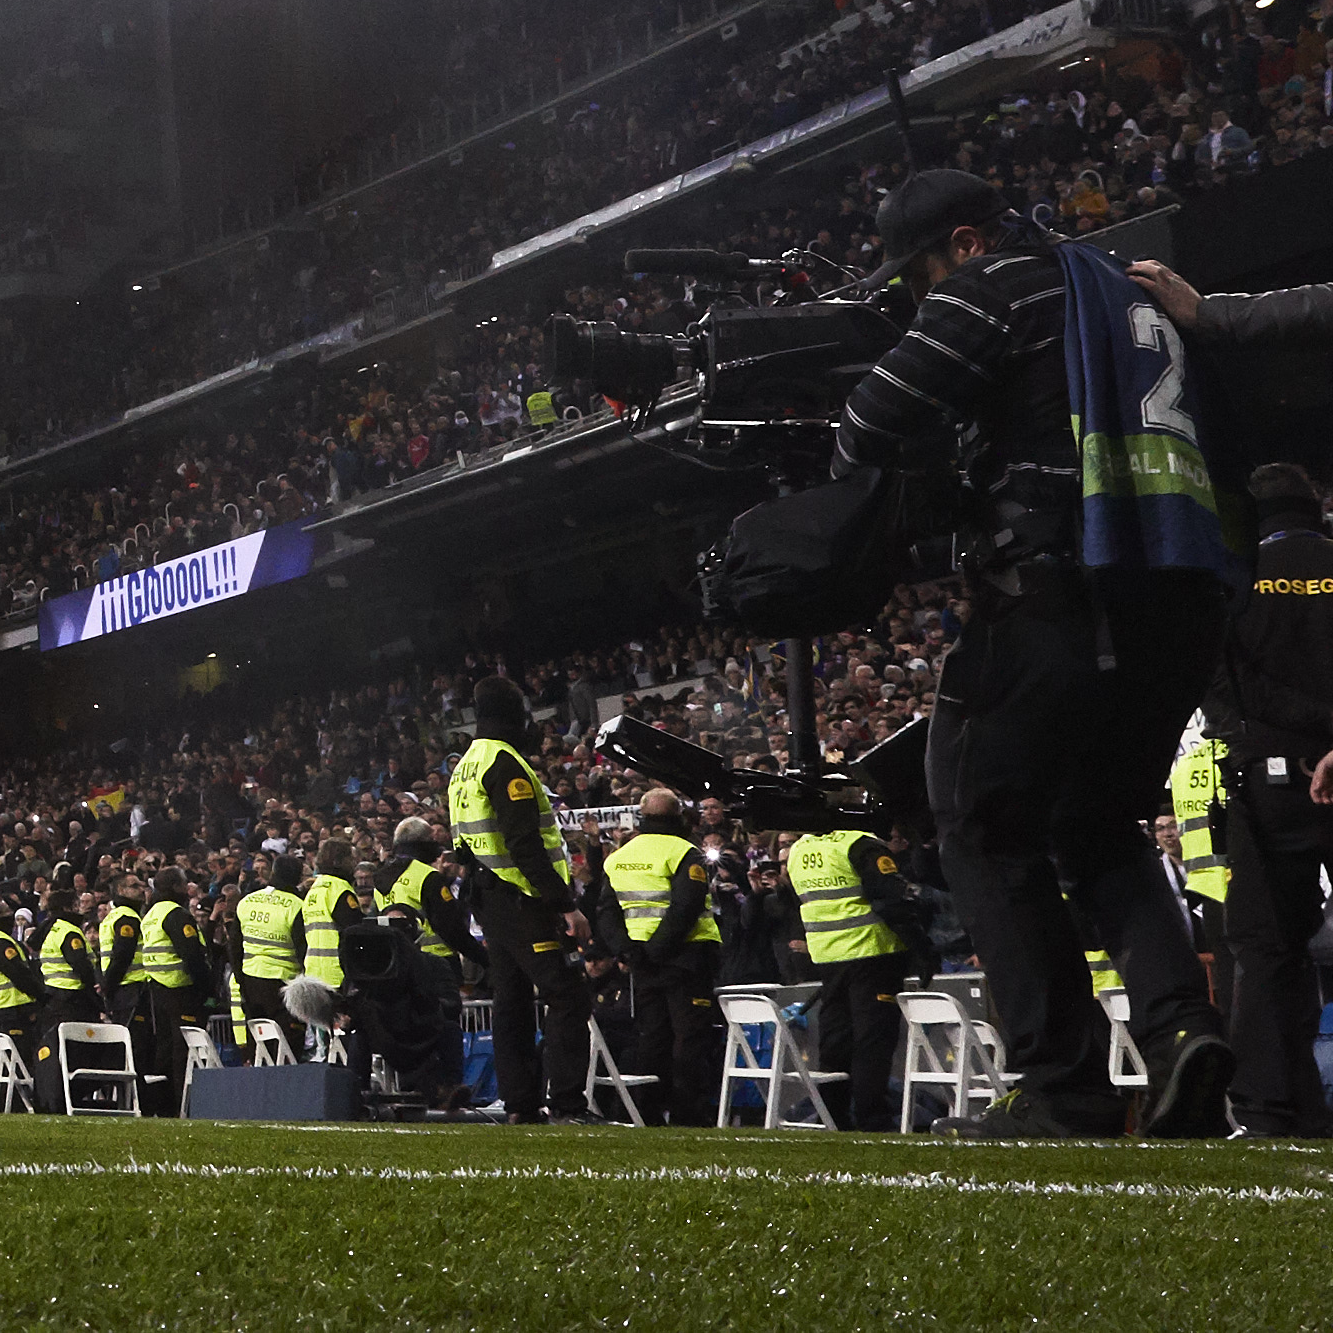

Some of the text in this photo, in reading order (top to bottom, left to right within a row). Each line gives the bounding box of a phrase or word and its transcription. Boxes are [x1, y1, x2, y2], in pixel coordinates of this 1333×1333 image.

[1254, 577, 1333, 596] ROSEG
[1190, 769, 1210, 789] 55
[802, 852, 824, 870] 993
[249, 910, 270, 924] 988
